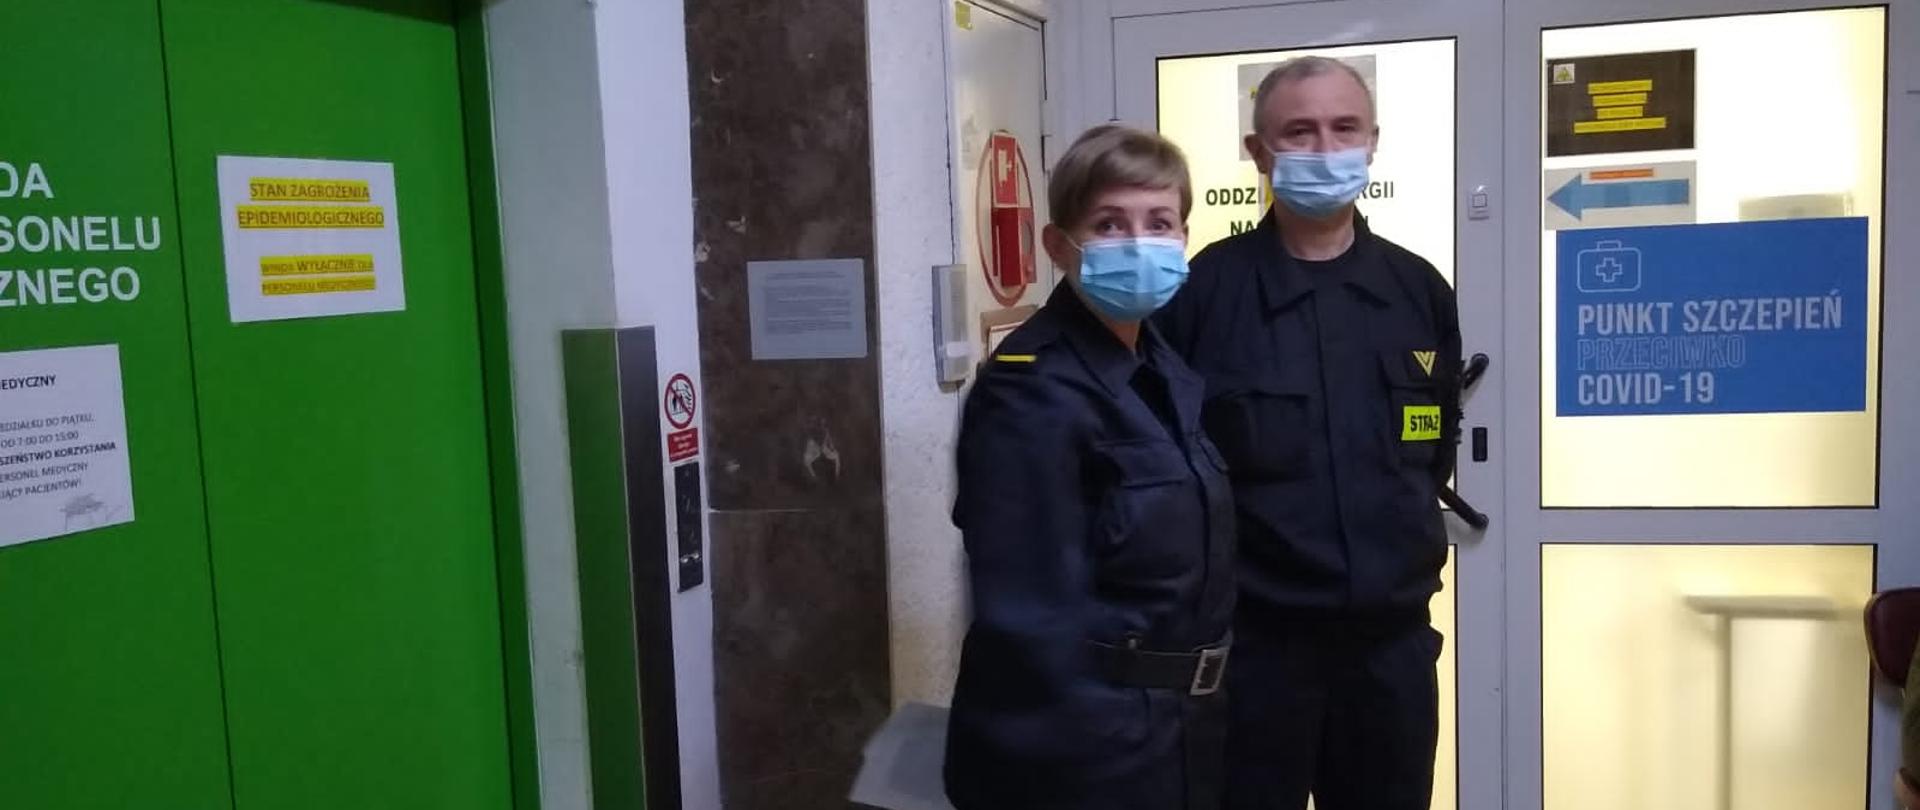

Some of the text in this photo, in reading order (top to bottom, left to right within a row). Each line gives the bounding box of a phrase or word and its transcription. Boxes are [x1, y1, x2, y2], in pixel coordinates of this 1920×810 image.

[0, 161, 54, 199] DA
[250, 183, 286, 198] STAN
[1205, 187, 1257, 206] ODDZ
[238, 210, 384, 225] EPIDEMIOLOGICZNEGO
[0, 215, 161, 253] SONELU
[0, 266, 140, 307] ZNEGO
[1578, 288, 1843, 336] PUNKT SZCZEPIEŃ
[1576, 334, 1746, 371] PRZECIWKO
[0, 374, 56, 390] EDYCZNY
[1578, 371, 1715, 405] COVID-19
[46, 417, 59, 428] DO
[39, 434, 52, 445] DO
[55, 442, 116, 458] KORZYSTANIA
[42, 462, 88, 476] MEDYCZNY
